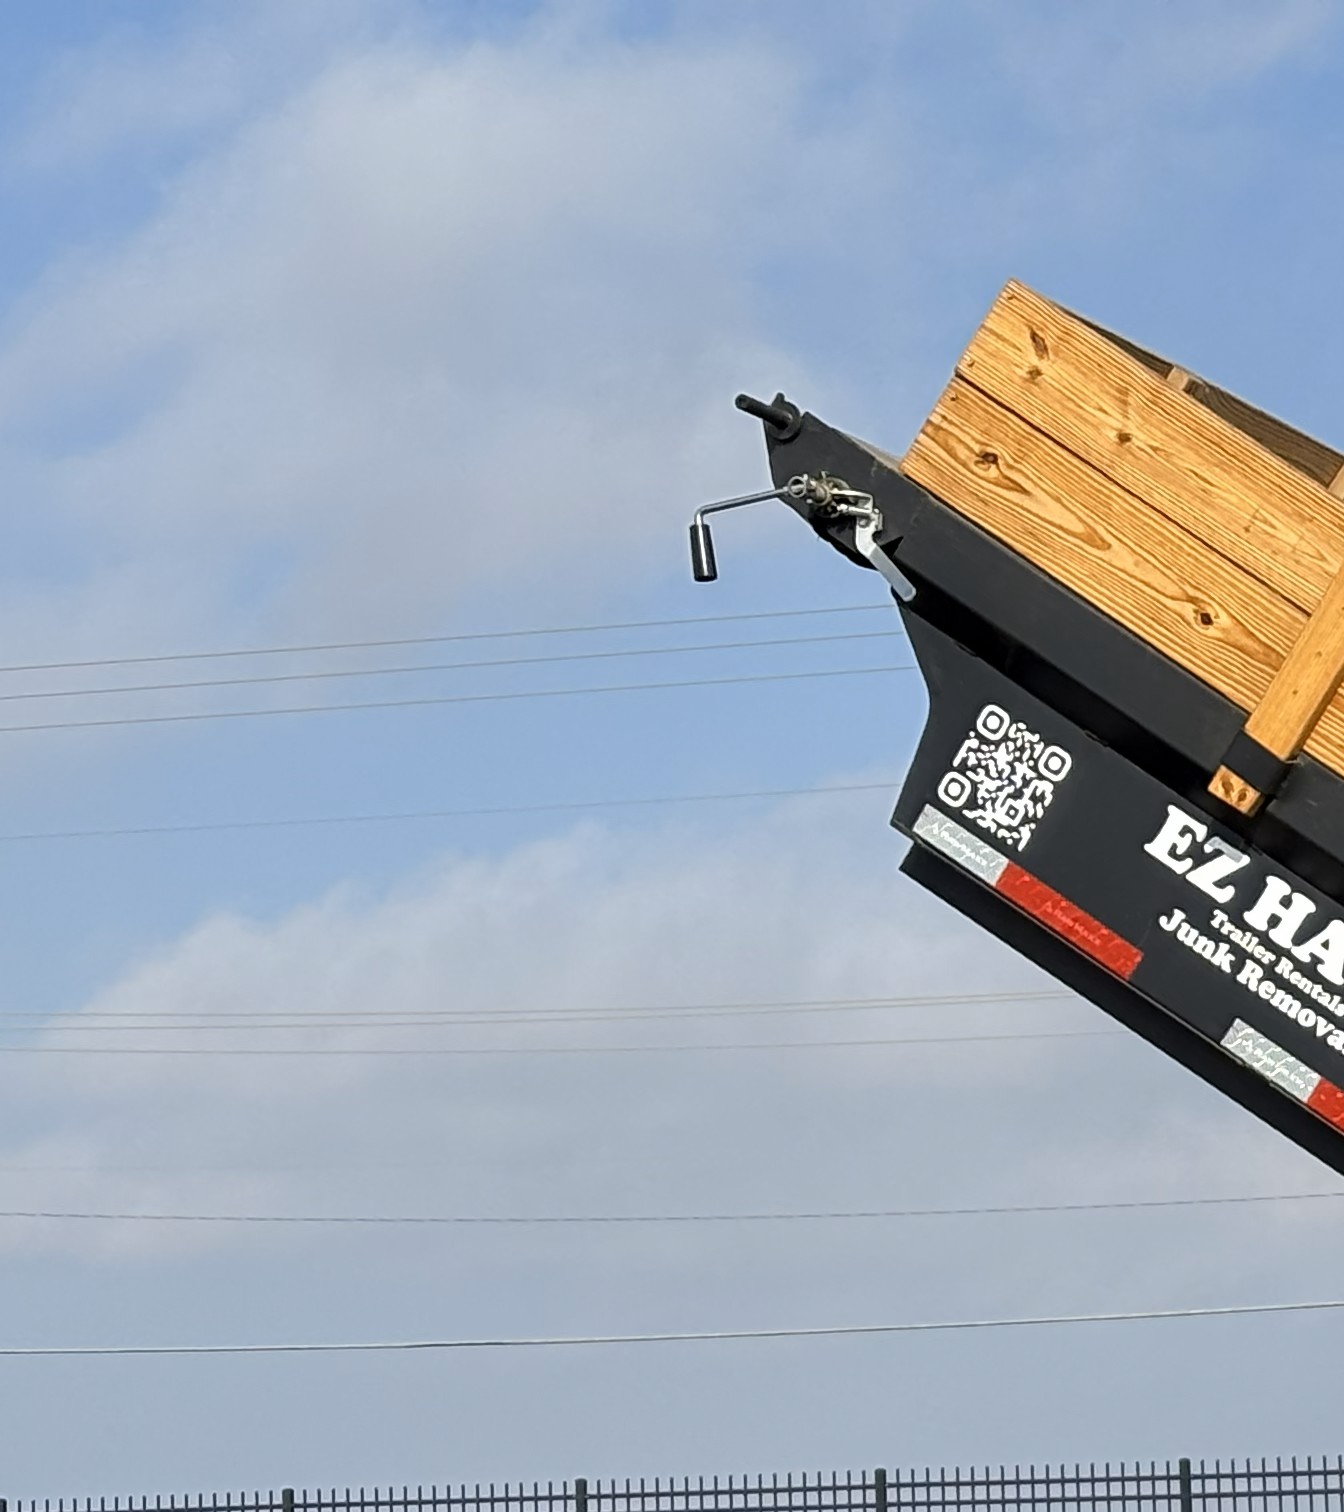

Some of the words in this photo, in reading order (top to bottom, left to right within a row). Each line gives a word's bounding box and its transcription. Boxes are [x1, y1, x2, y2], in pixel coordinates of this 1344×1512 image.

[1144, 805, 1250, 904] EZ
[1159, 908, 1236, 974] Junk
[1210, 909, 1277, 964] Trailer
